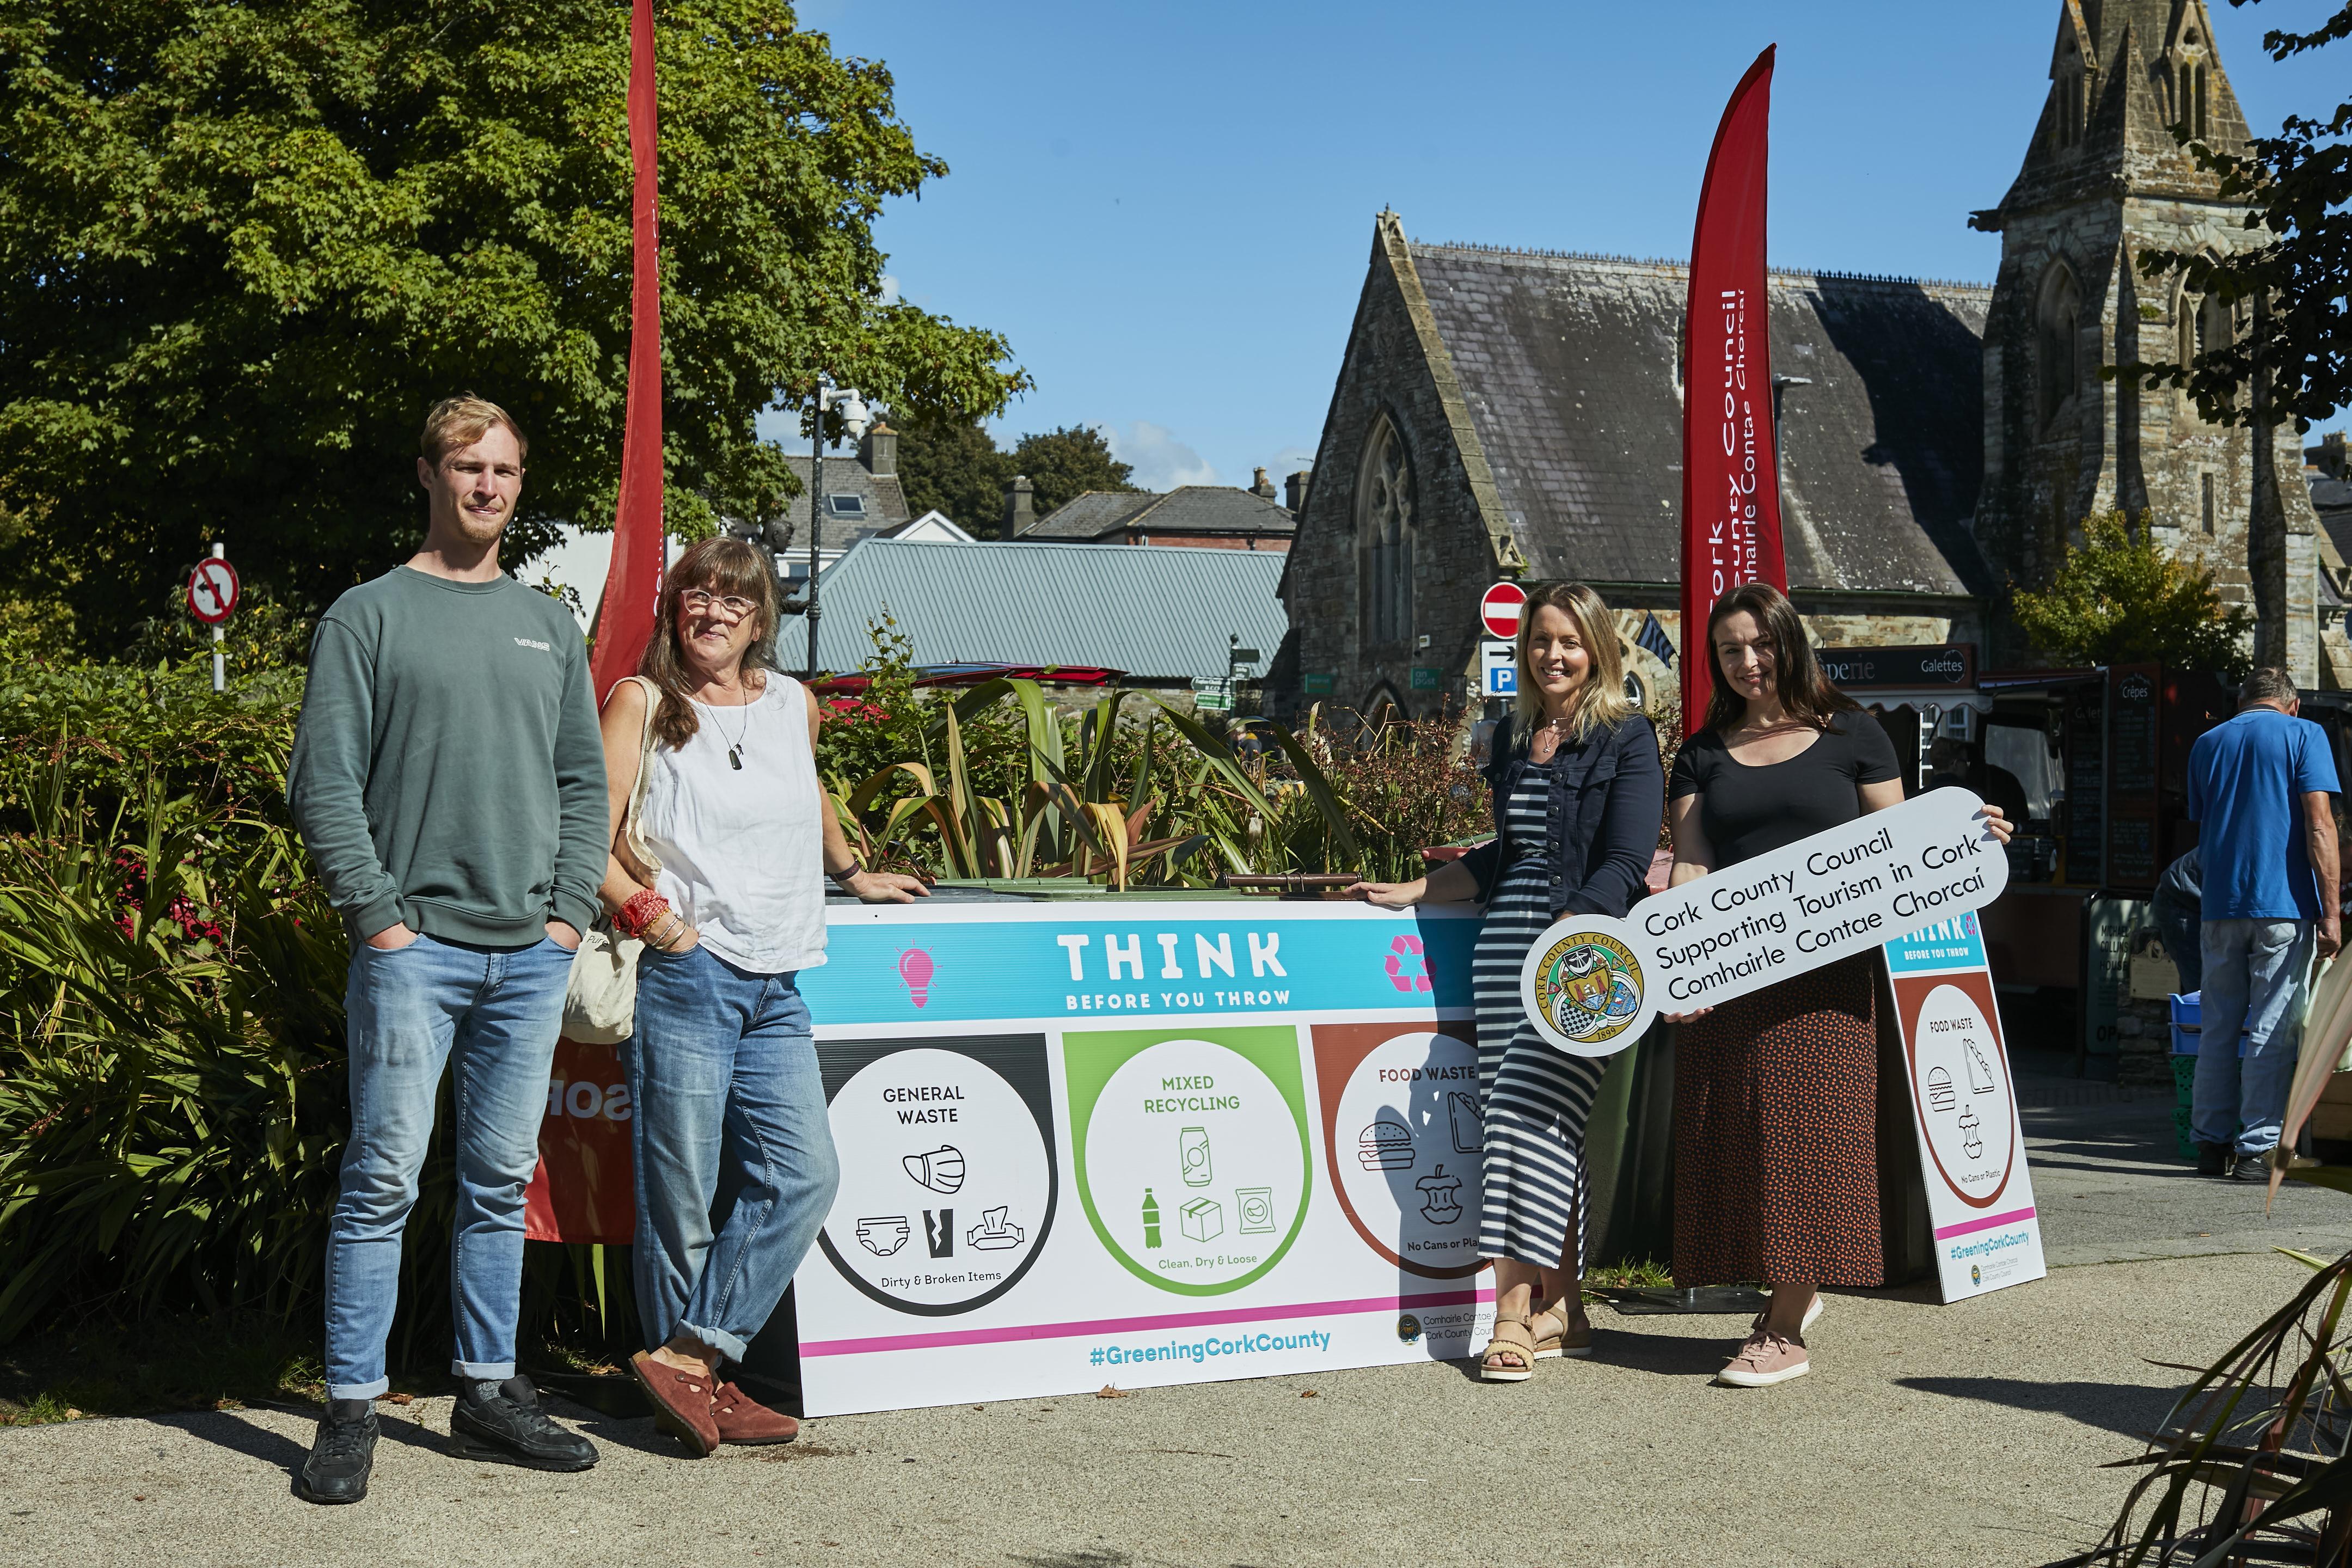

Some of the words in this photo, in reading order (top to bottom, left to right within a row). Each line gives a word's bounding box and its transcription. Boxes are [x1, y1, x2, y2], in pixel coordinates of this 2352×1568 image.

[1722, 291, 1735, 456] Council
[1741, 401, 1755, 494] Contae
[1709, 520, 1723, 614] ork
[514, 638, 550, 651] VANS
[1921, 658, 1963, 672] Galettes
[1416, 670, 1428, 678] an
[1416, 677, 1435, 685] post
[1498, 670, 1512, 689] P
[2122, 684, 2148, 701] Crêpes
[1645, 902, 1702, 936] Cork
[1712, 871, 1793, 911] County
[1807, 828, 1893, 876] Council
[1656, 911, 1786, 969] Supporting
[1793, 876, 1882, 917] Tourism
[1889, 863, 1913, 883] in
[1922, 834, 1982, 869] Cork
[1669, 946, 1786, 1000] Comhairle
[1796, 913, 1883, 953] Contae
[1893, 866, 1985, 917] Chorcaí
[2101, 926, 2129, 937] MICHAEL
[587, 935, 609, 947] Pure
[2100, 941, 2129, 953] COLLINS
[1057, 933, 1288, 981] THINK
[1542, 935, 1586, 968] COUNTY
[1592, 935, 1638, 975] COUNCIL
[1904, 950, 1930, 960] BEFORE
[1931, 948, 1945, 958] YOU
[1946, 947, 1969, 957] THROW
[2100, 960, 2129, 971] HOUSE
[1538, 974, 1548, 1009] CORK
[1066, 994, 1151, 1010] BEFORE
[1161, 993, 1204, 1007] YOU
[1215, 990, 1290, 1006] THROW
[1596, 1027, 1616, 1040] 1899
[1930, 1020, 1949, 1033] FOOD
[1950, 1018, 1973, 1031] WASTE
[1379, 1068, 1422, 1082] FOOD
[1425, 1066, 1475, 1081] WASTE
[1162, 1076, 1214, 1091] MIXED
[883, 1086, 965, 1102] GENERAL
[1144, 1095, 1240, 1113] RECYCLING
[897, 1108, 958, 1124] WASTE
[1961, 1175, 1968, 1184] No
[1969, 1173, 1980, 1183] Cans
[1986, 1169, 2001, 1179] Plastic
[1407, 1241, 1421, 1251] No
[1423, 1240, 1448, 1250] Cans
[1951, 1230, 2029, 1260] #GreeningCorkCounty
[1159, 1258, 1193, 1269] Clean,
[1196, 1257, 1215, 1270] Dry
[1218, 1255, 1224, 1265] &
[1228, 1255, 1257, 1264] Loose
[881, 1277, 910, 1289] Dirty
[914, 1276, 921, 1285] &
[925, 1273, 965, 1284] Broken
[969, 1271, 1001, 1282] Items
[1424, 1313, 1461, 1325] Comhairle
[1463, 1312, 1491, 1322] Contae
[1426, 1330, 1443, 1340] Cork
[1445, 1329, 1472, 1340] County
[1089, 1330, 1331, 1366] #GreeningCorkCounty
